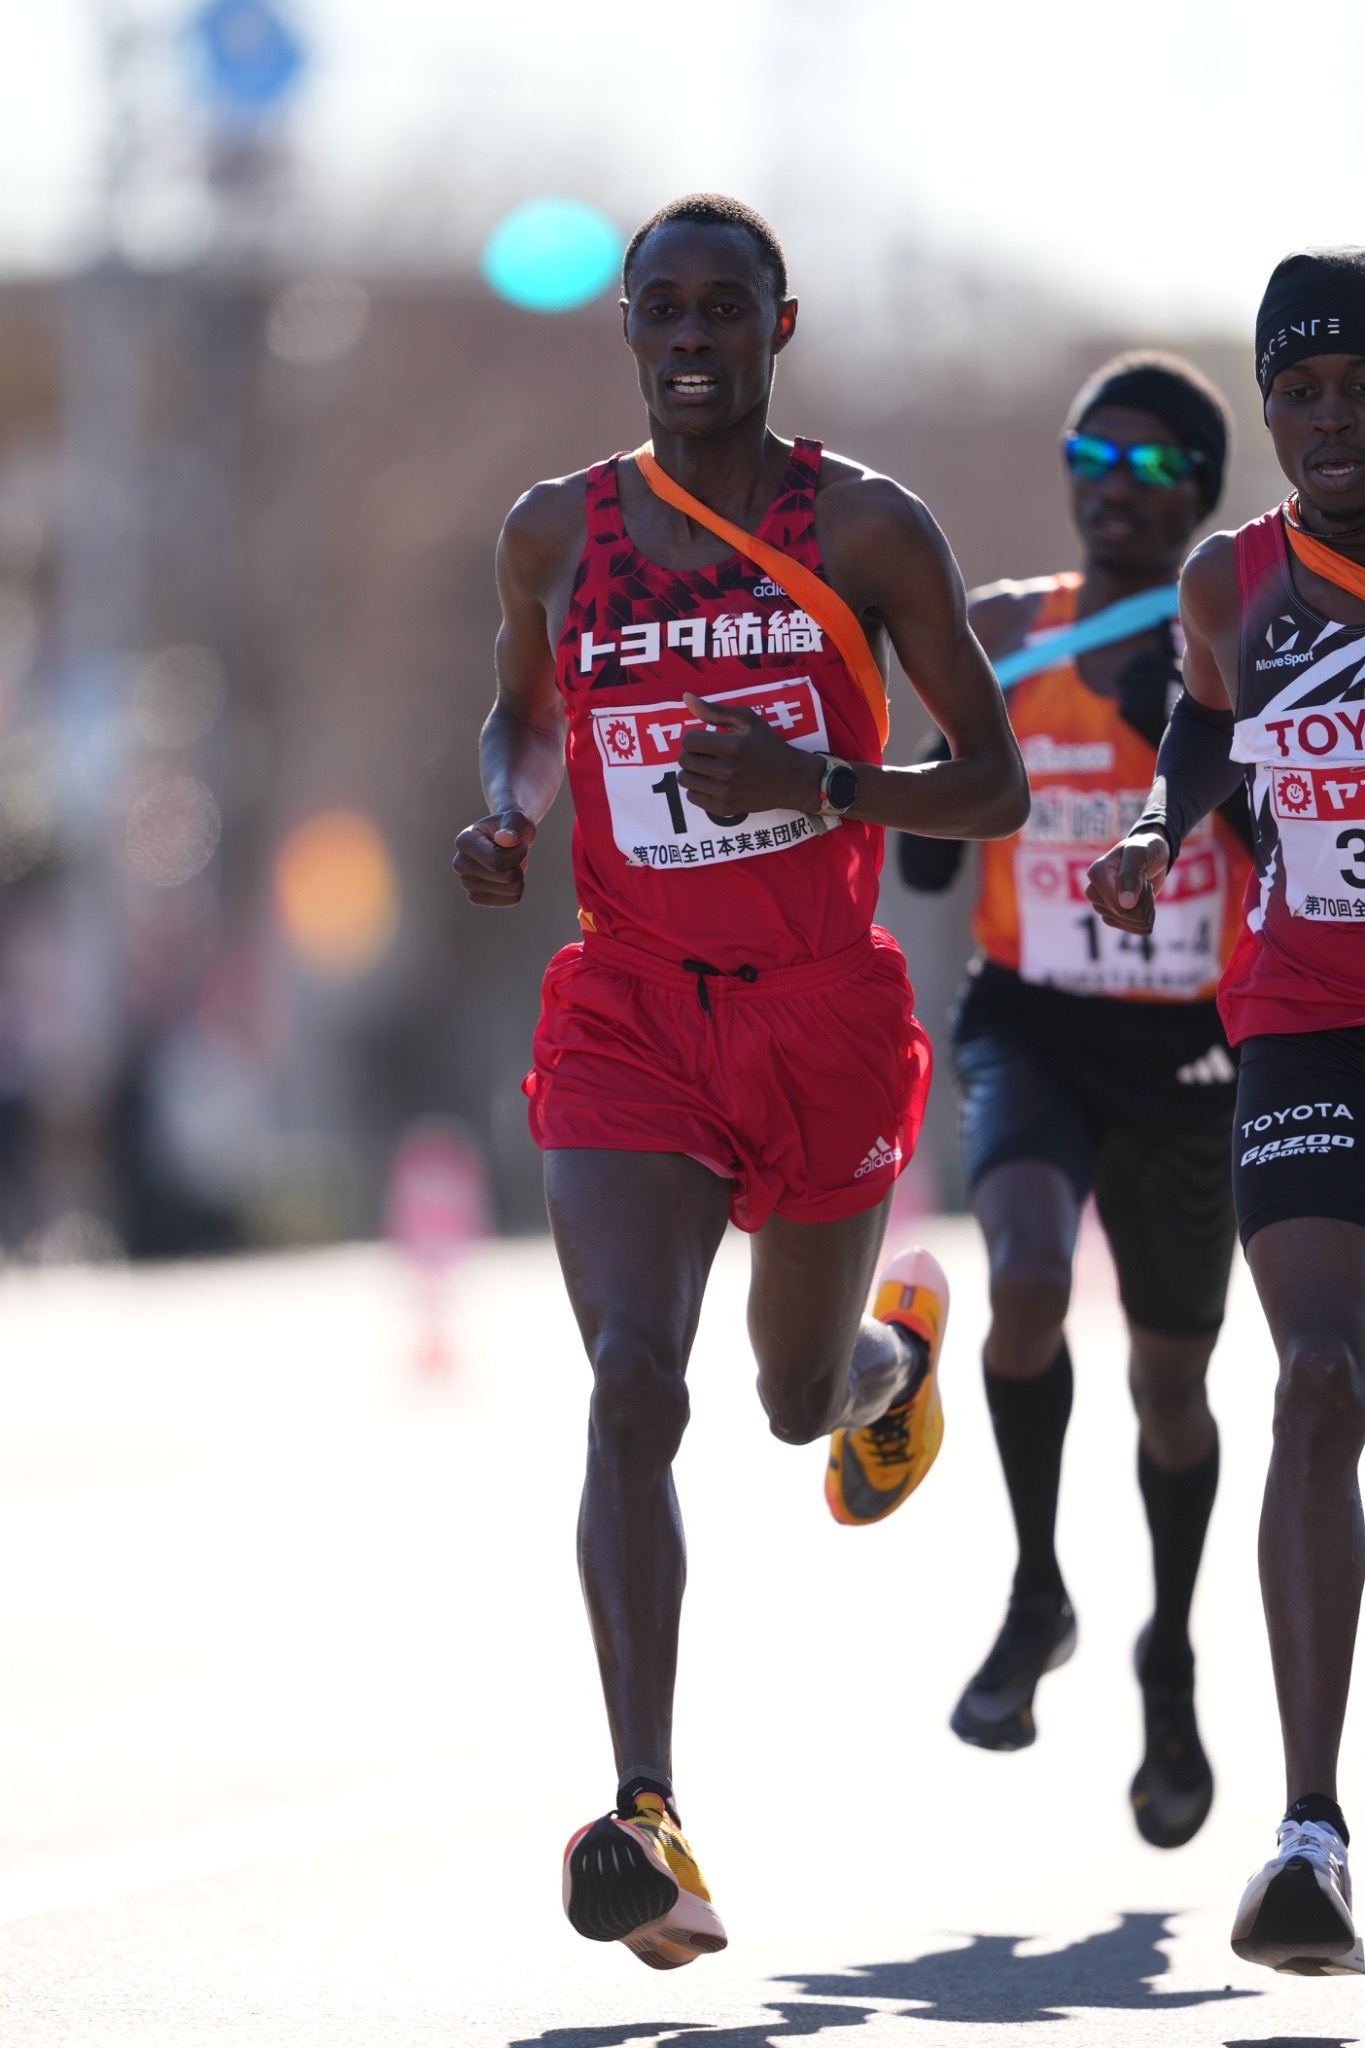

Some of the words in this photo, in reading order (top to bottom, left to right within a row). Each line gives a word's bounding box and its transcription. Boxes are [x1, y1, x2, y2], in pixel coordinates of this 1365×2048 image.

[579, 610, 824, 674] トヨタ紡織
[1255, 650, 1314, 671] MoveSport
[1241, 1102, 1355, 1139] TOYOTA
[853, 1148, 903, 1179] adidas
[1240, 1133, 1355, 1167] GAZOO
[1255, 1145, 1332, 1166] SPORTS
